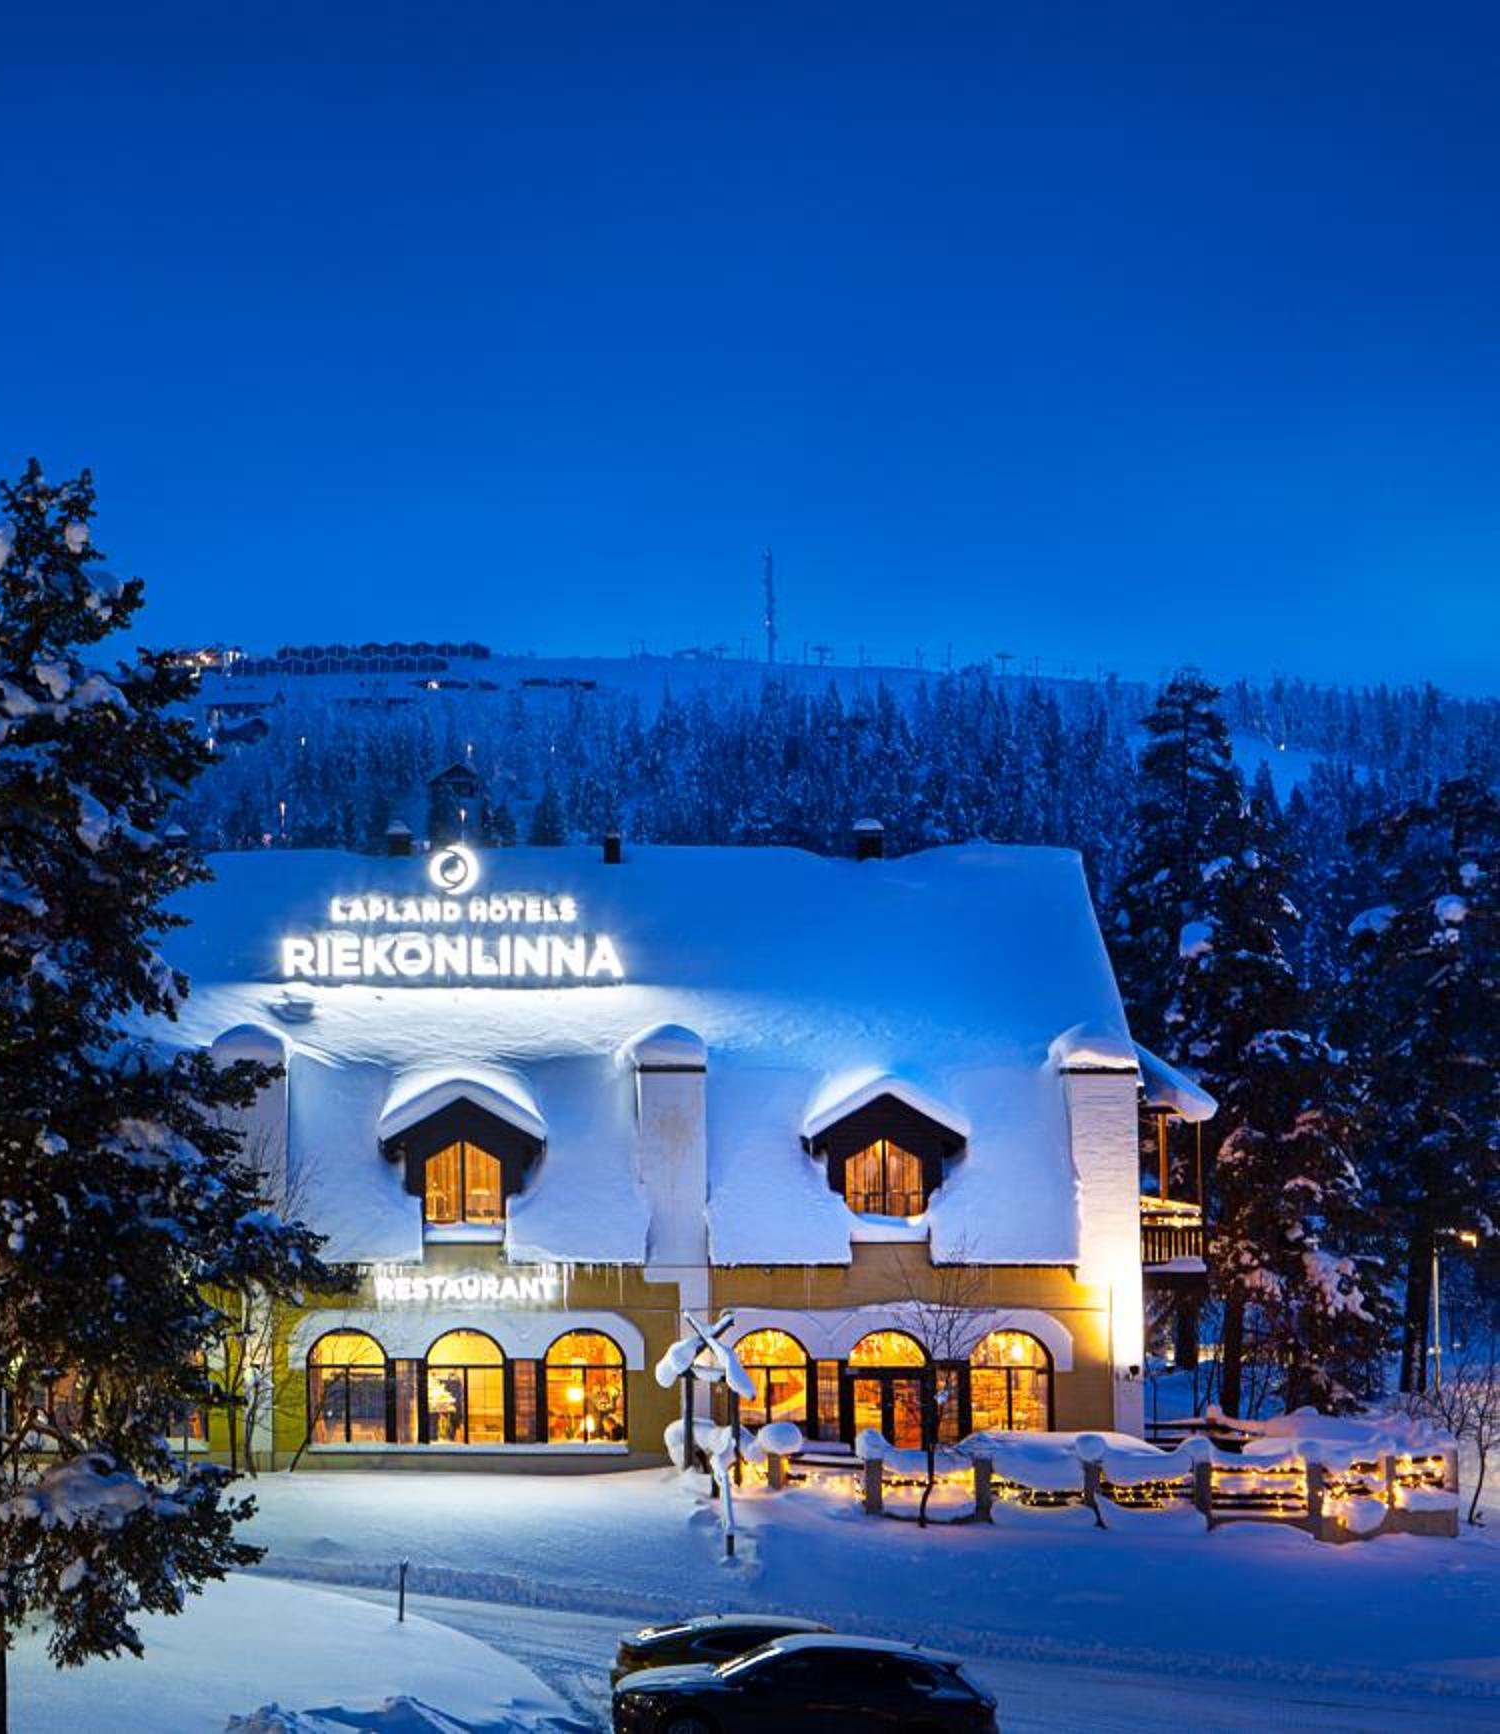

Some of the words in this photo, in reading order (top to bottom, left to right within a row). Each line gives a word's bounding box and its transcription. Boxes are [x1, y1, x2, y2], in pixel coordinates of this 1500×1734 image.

[331, 897, 462, 923] LAPLAND
[469, 897, 577, 923] HOTELS
[282, 935, 625, 977] RIEKONLINNA
[375, 1276, 559, 1300] RESTAURANT
